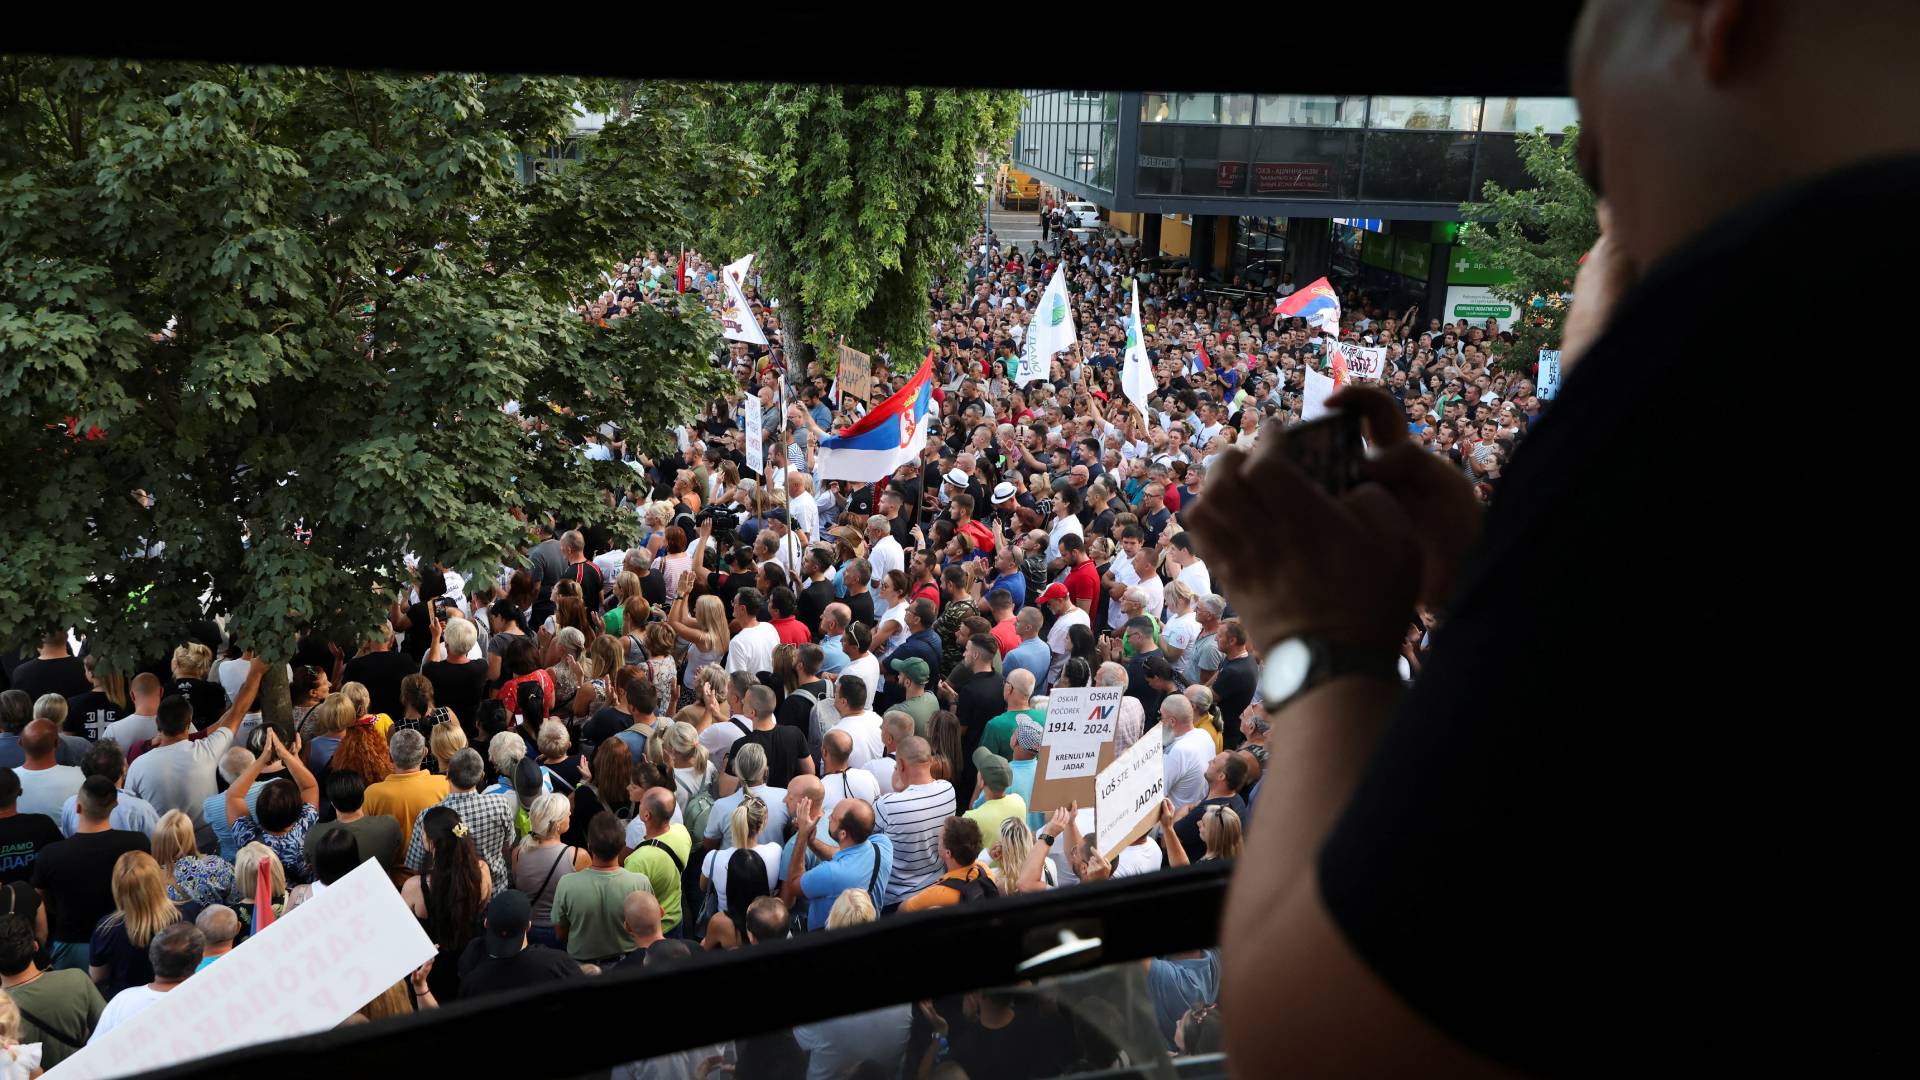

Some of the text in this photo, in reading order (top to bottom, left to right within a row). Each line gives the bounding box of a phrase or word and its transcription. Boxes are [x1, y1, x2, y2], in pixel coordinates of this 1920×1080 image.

[1057, 695, 1079, 703] OSKAR
[1089, 692, 1119, 702] OSKAR
[1088, 705, 1115, 720] AV
[1048, 721, 1077, 733] 1914.
[1083, 724, 1112, 734] 2024.
[1055, 751, 1095, 761] KRENULI NA
[1062, 762, 1085, 771] JADAR
[1134, 777, 1163, 813] JADAR
[2, 842, 34, 853] ДАМО
